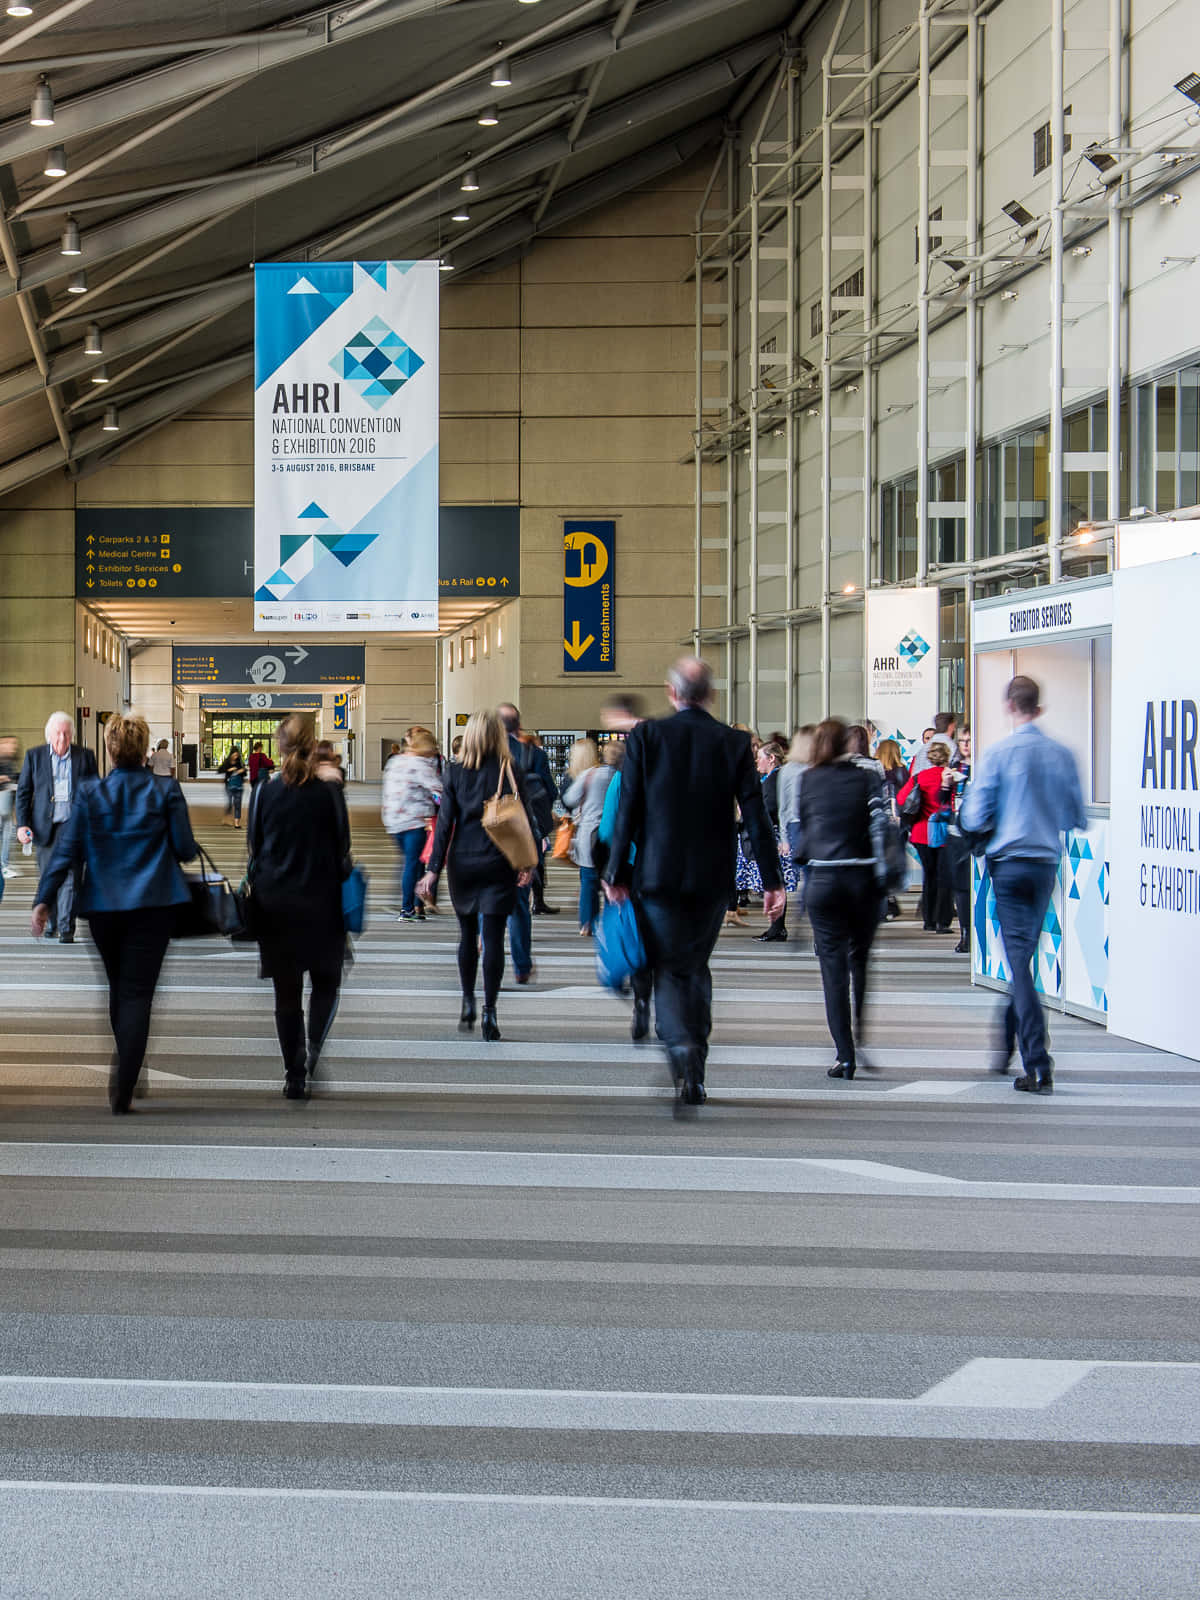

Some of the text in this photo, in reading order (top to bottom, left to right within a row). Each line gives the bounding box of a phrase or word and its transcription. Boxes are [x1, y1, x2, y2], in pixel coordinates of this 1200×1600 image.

[272, 383, 340, 413] AHRI
[272, 417, 401, 434] NATIONAL CONVENTION
[272, 437, 376, 454] & EXHIBITION 2016
[272, 463, 376, 473] 3-5 AUGUST 2016, BRISBANE
[99, 536, 134, 544] Carparks
[98, 550, 157, 558] Medical Centre
[100, 579, 123, 587] Toilets
[439, 578, 450, 586] us
[460, 578, 474, 586] Rail
[600, 583, 610, 662] Refreshments
[1009, 602, 1072, 632] EXHIBITOR SERVICES
[262, 661, 277, 682] 2
[873, 656, 899, 671] AHRI
[256, 693, 267, 708] 3
[1141, 804, 1195, 853] NATIONAL
[1140, 863, 1200, 915] & EXHIBITI
